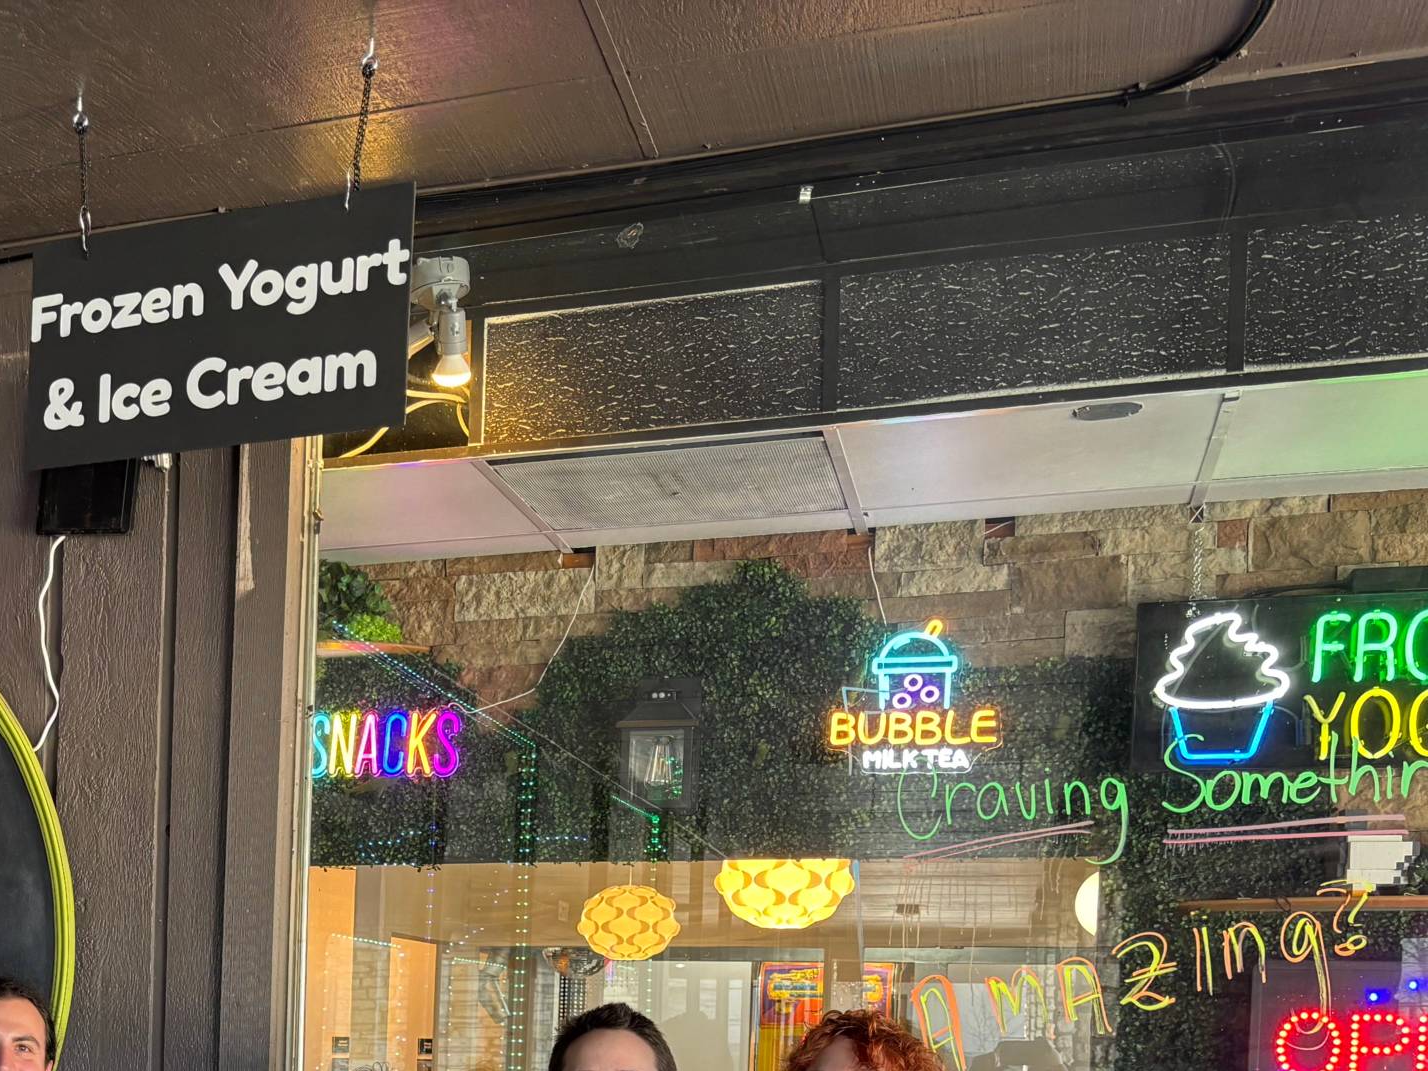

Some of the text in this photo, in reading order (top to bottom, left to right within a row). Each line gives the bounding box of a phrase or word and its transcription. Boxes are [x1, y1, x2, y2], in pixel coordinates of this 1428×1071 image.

[30, 238, 410, 343] Frozen Yogurt
[43, 348, 377, 431] & Ice Cream
[312, 711, 461, 778] SNACKS
[829, 709, 997, 746] BUBBLE
[862, 747, 970, 769] MILK TEA
[897, 732, 1428, 865] Craving Somethin
